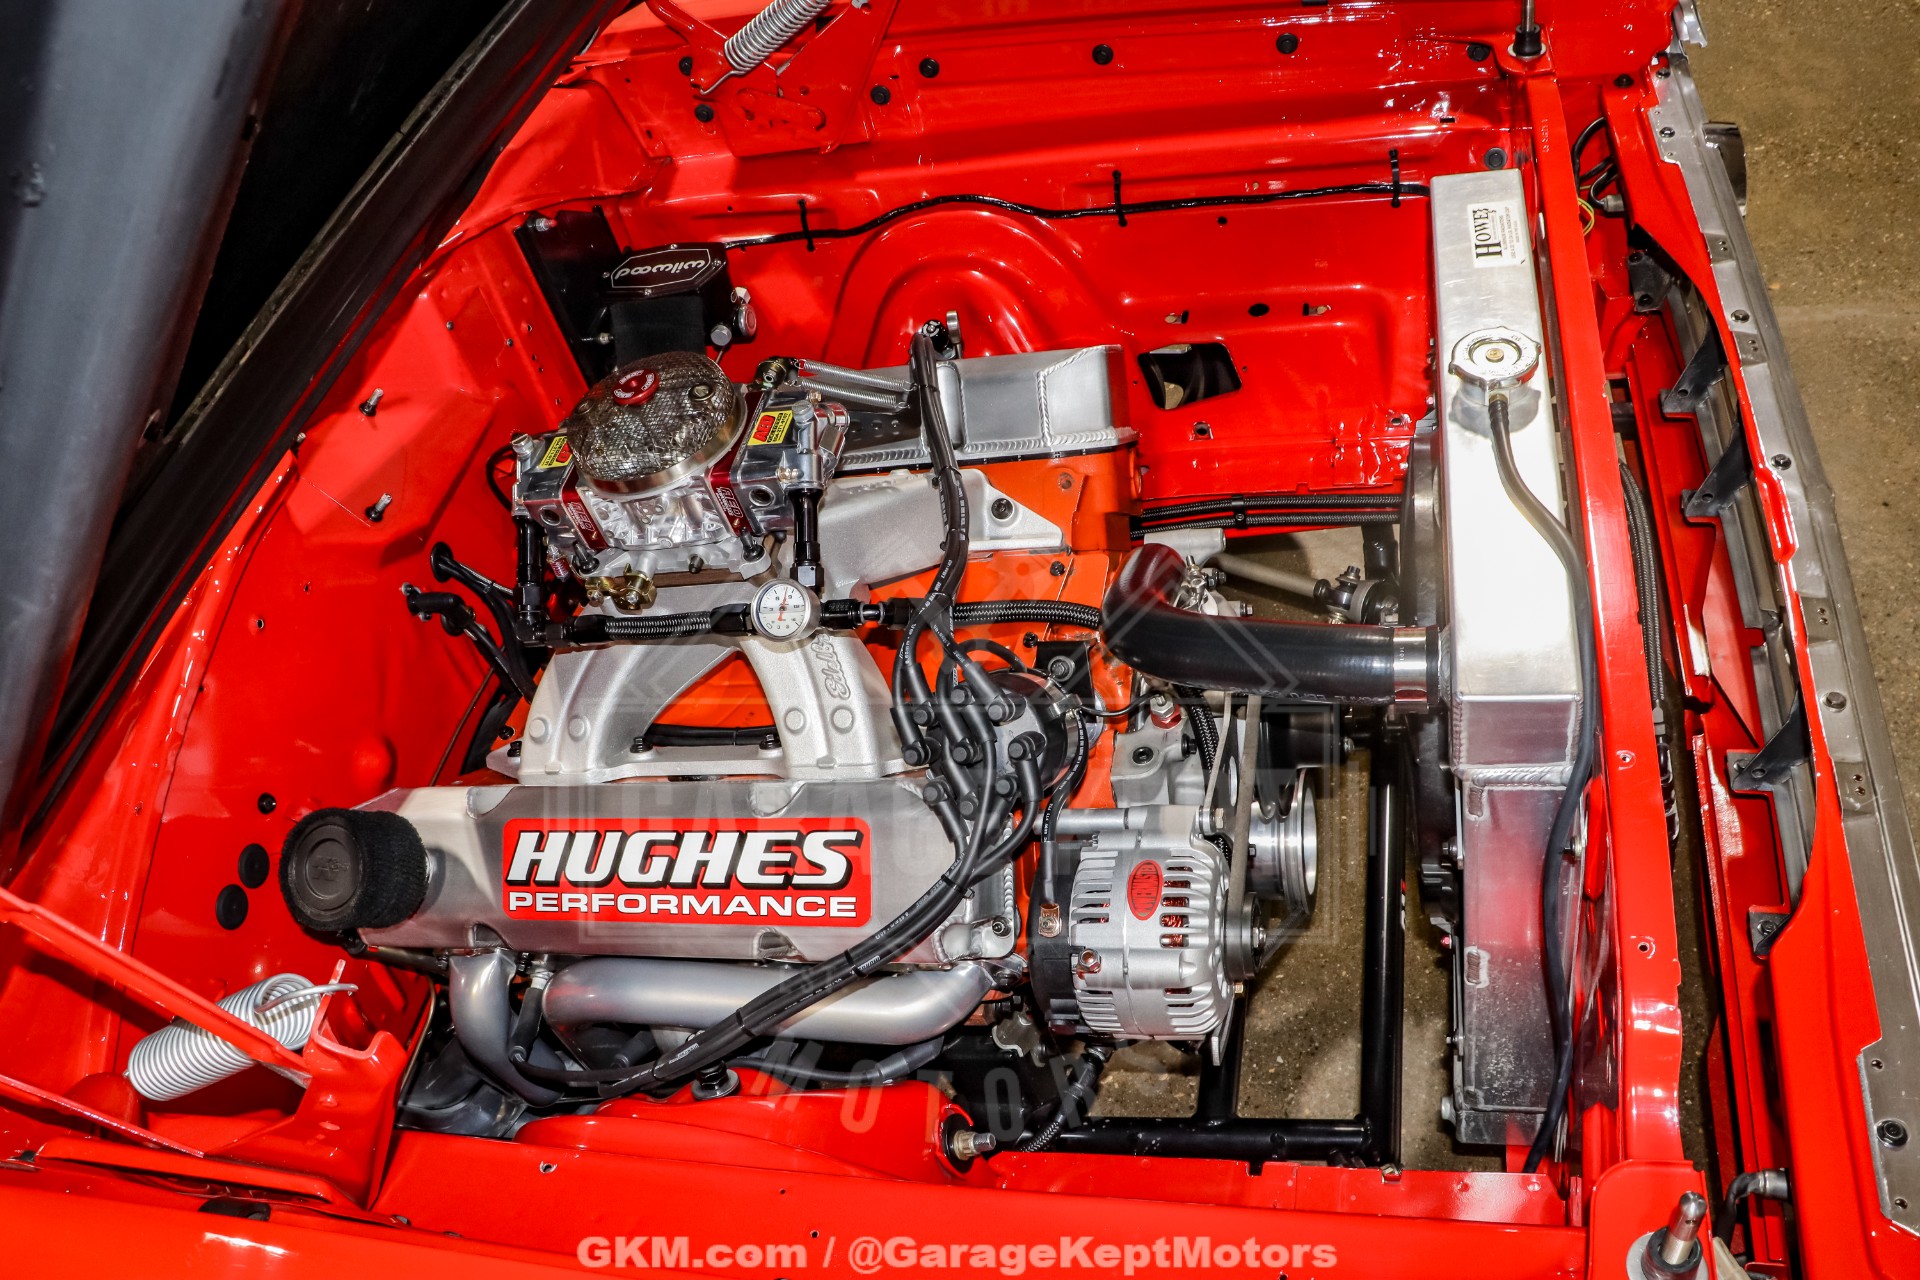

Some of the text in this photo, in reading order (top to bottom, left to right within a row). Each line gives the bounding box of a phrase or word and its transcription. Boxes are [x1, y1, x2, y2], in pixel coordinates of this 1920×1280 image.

[614, 260, 706, 280] wilwood
[752, 413, 776, 443] AED
[506, 830, 863, 890] HUGHES
[509, 891, 858, 918] PERFORMANCE
